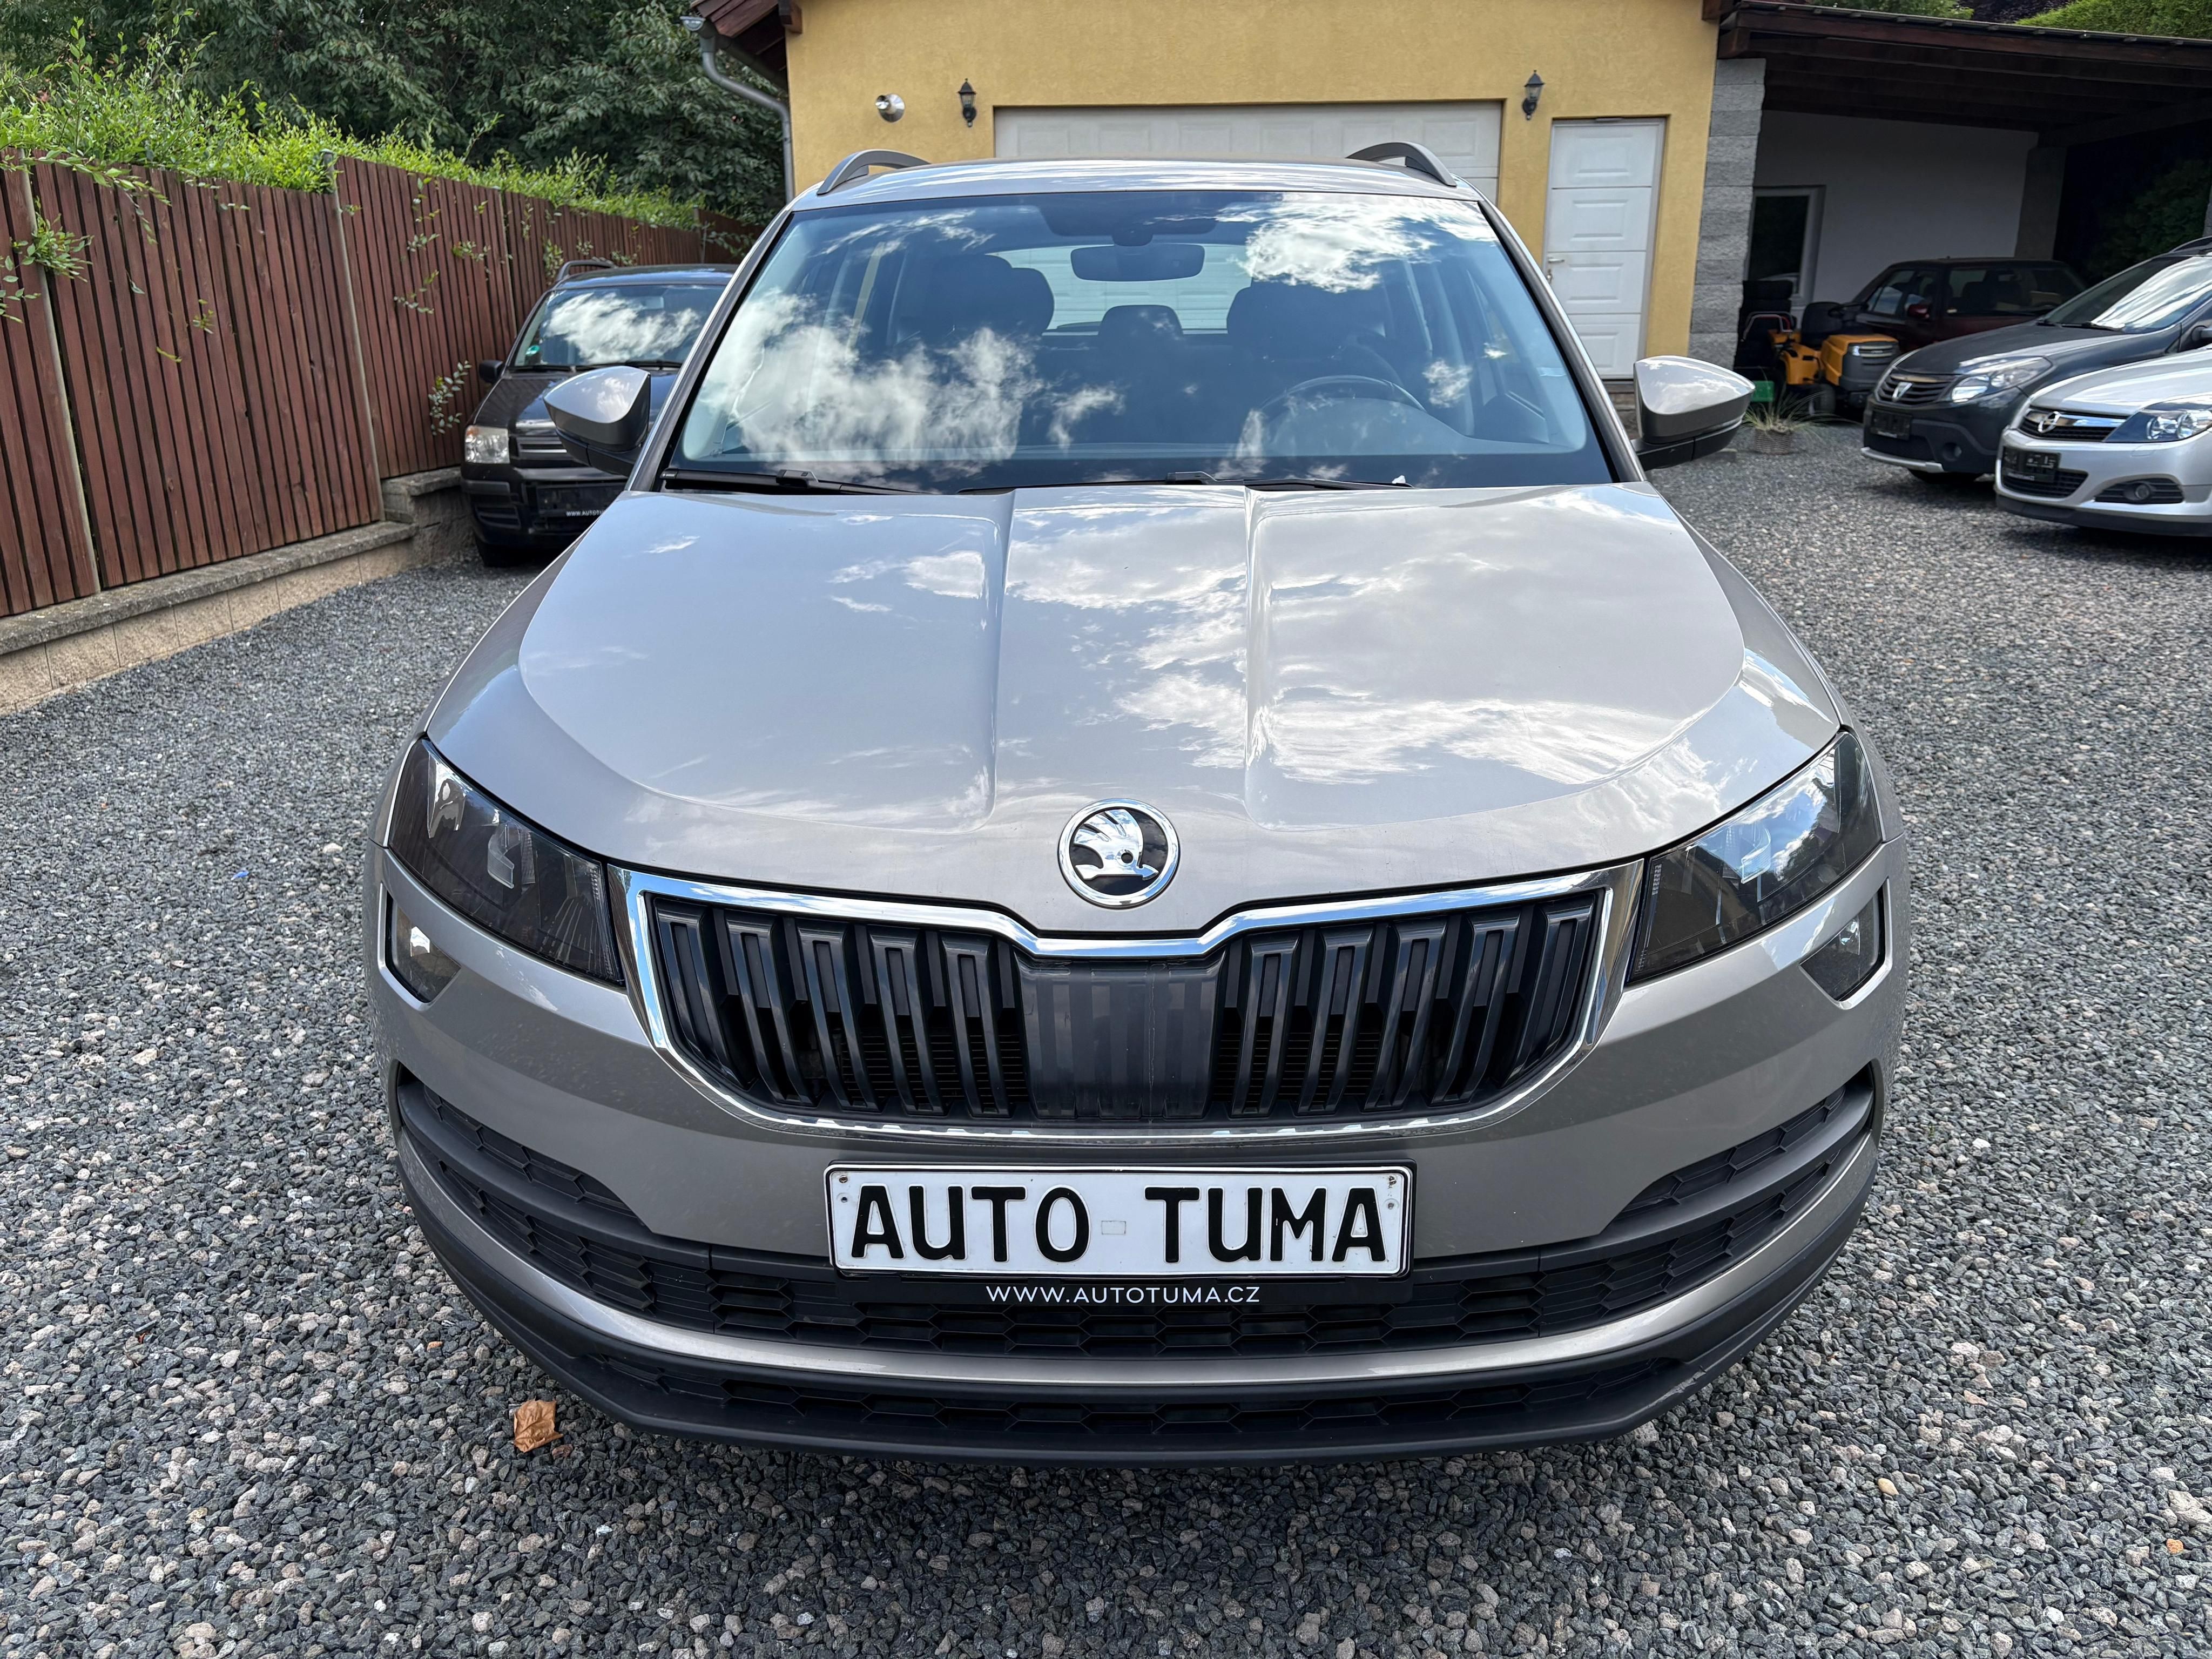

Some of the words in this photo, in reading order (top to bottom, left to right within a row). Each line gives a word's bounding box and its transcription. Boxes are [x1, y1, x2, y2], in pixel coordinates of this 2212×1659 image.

[851, 1185, 1089, 1263] AUTO
[1144, 1187, 1386, 1263] TUMA
[986, 1286, 1260, 1304] WWW.AUTOTUMA.CZ
